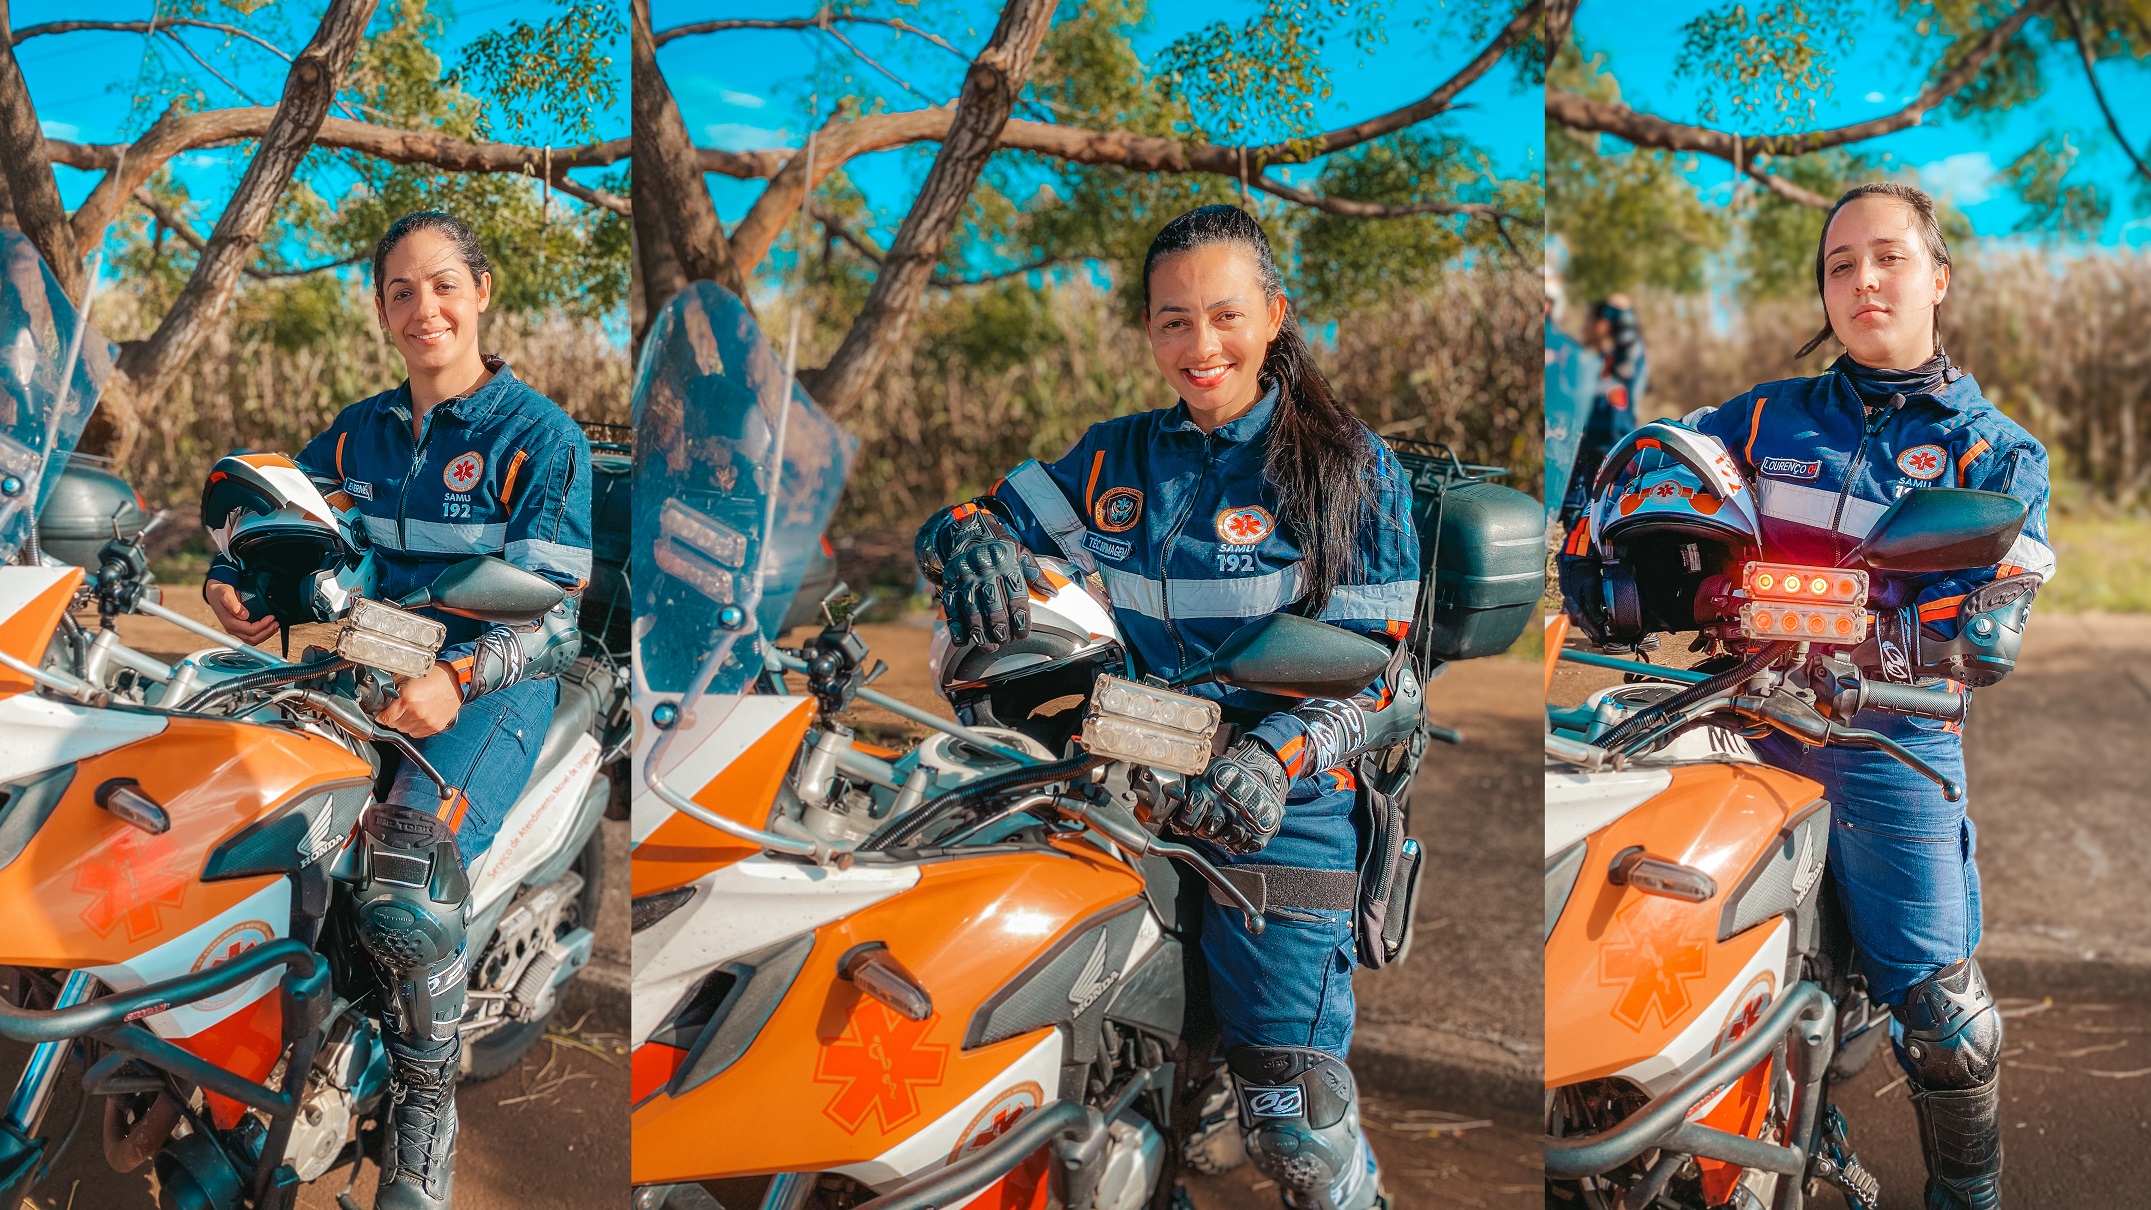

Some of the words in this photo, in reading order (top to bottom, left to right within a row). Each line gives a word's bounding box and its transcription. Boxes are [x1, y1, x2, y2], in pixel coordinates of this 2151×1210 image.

[1764, 460, 1807, 474] LOURENÇO
[1899, 477, 1932, 487] SAMU
[444, 493, 471, 501] SAMU
[443, 502, 471, 518] 192
[1219, 544, 1256, 552] SAMU
[1217, 554, 1255, 571] 192
[300, 833, 345, 869] HONDA
[1796, 861, 1824, 906] HONDA
[1072, 970, 1120, 1018] HONDA
